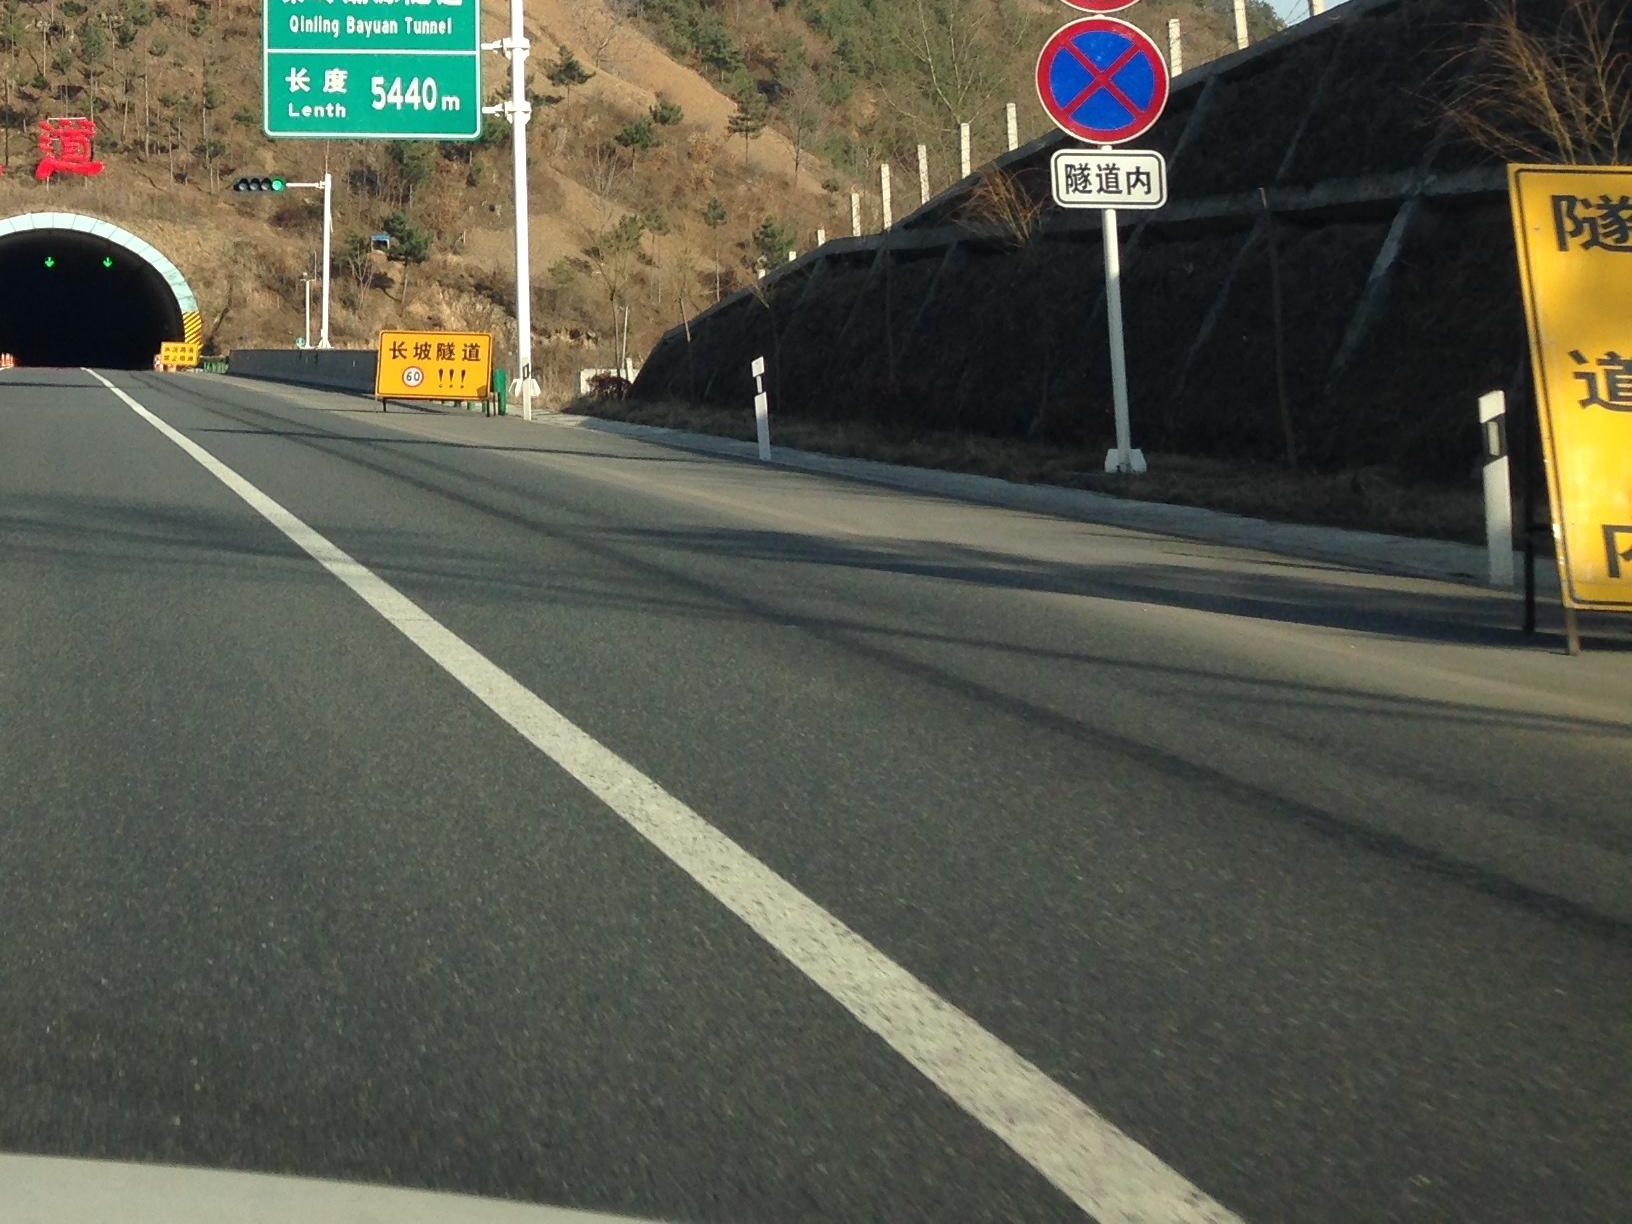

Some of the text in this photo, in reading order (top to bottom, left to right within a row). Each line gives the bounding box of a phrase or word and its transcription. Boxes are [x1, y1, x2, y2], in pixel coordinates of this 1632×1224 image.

[289, 15, 452, 38] Qinling Bayuan Tunnel
[285, 67, 348, 94] 长度
[288, 102, 346, 118] Lenth
[1064, 163, 1152, 196] 隧道内
[389, 341, 481, 362] 长坡隧道
[406, 371, 420, 382] 60
